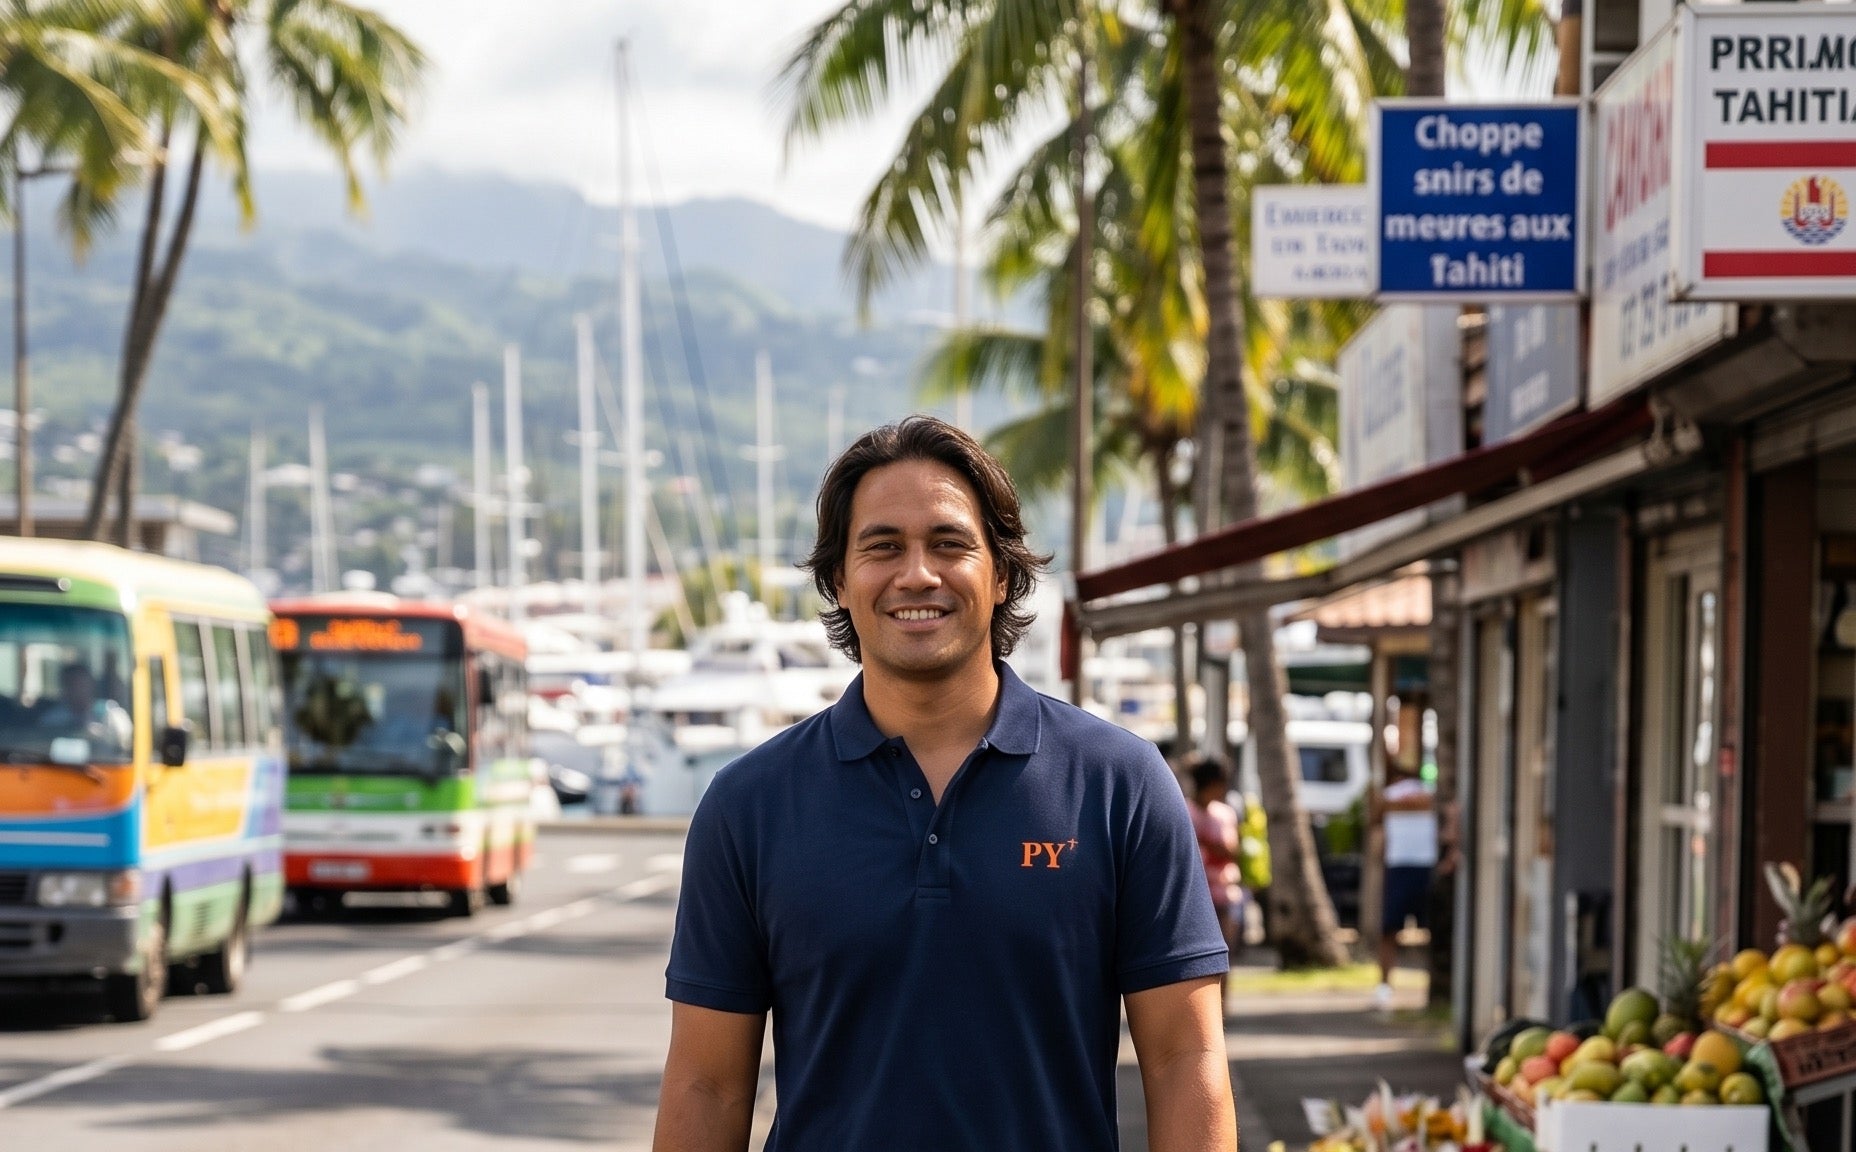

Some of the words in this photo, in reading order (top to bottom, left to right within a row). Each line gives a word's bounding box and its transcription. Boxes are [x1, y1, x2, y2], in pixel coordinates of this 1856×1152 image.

[1714, 88, 1856, 123] TAHITI
[1415, 115, 1543, 155] Choppe
[1414, 161, 1494, 195] snirs
[1501, 161, 1543, 195] de
[1385, 214, 1505, 240] meures
[1509, 214, 1571, 240] aux
[1431, 252, 1524, 286] Tahiti
